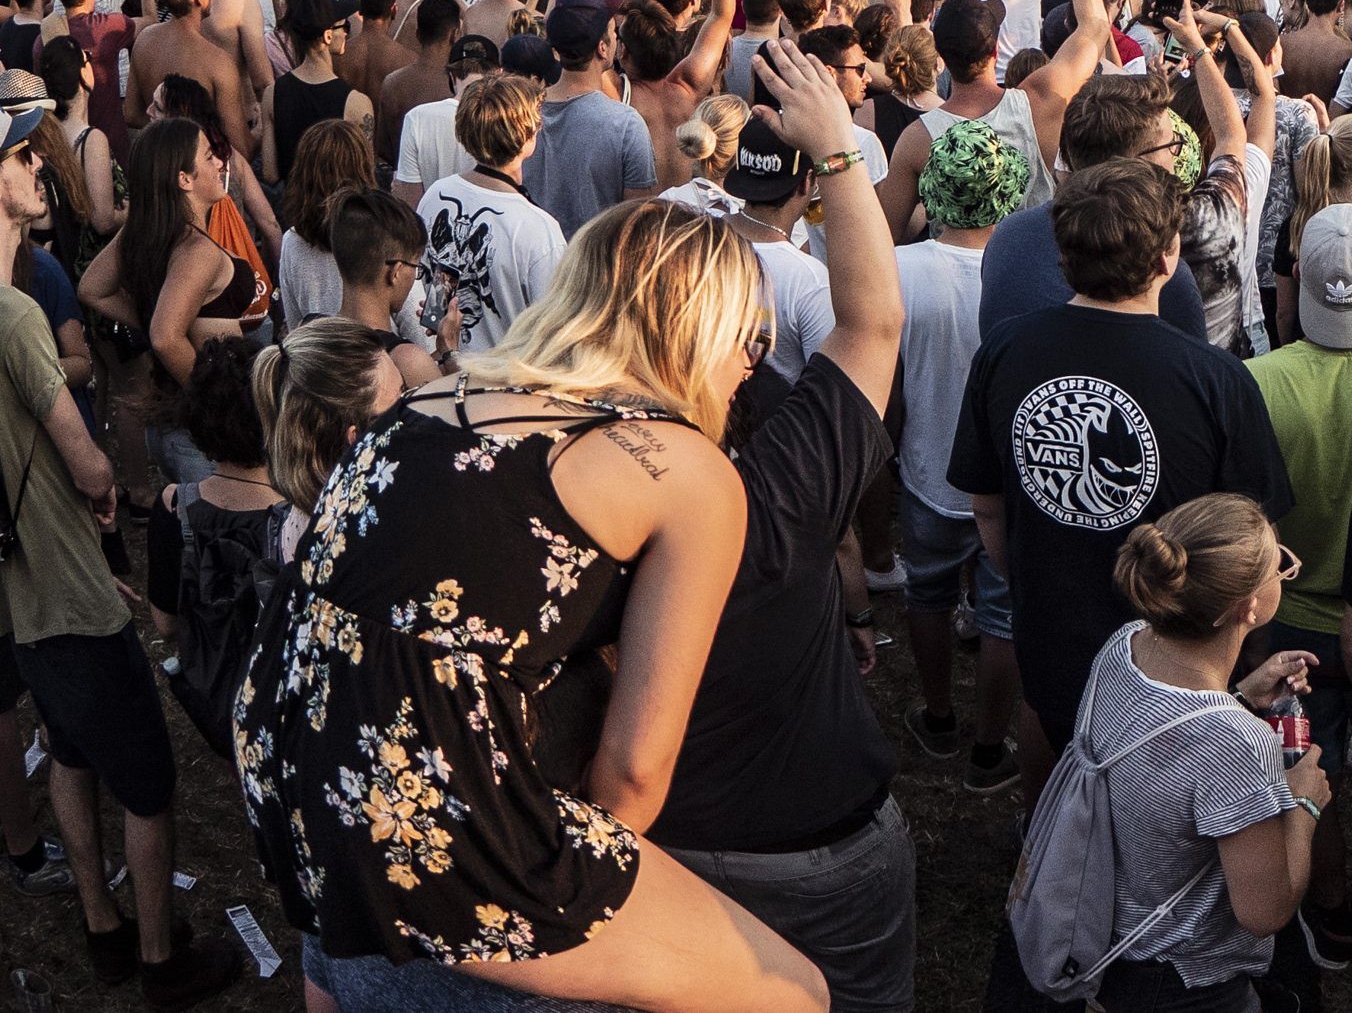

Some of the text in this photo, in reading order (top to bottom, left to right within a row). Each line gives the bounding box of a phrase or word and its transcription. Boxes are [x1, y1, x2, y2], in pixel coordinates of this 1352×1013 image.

[1024, 379, 1143, 425] VANS OFF THE WALL
[1015, 415, 1026, 435] LIT
[1026, 442, 1080, 468] VANS
[1140, 431, 1157, 493] SPITFIRE
[1076, 517, 1099, 528] THE
[1100, 492, 1149, 528] KEEPING
